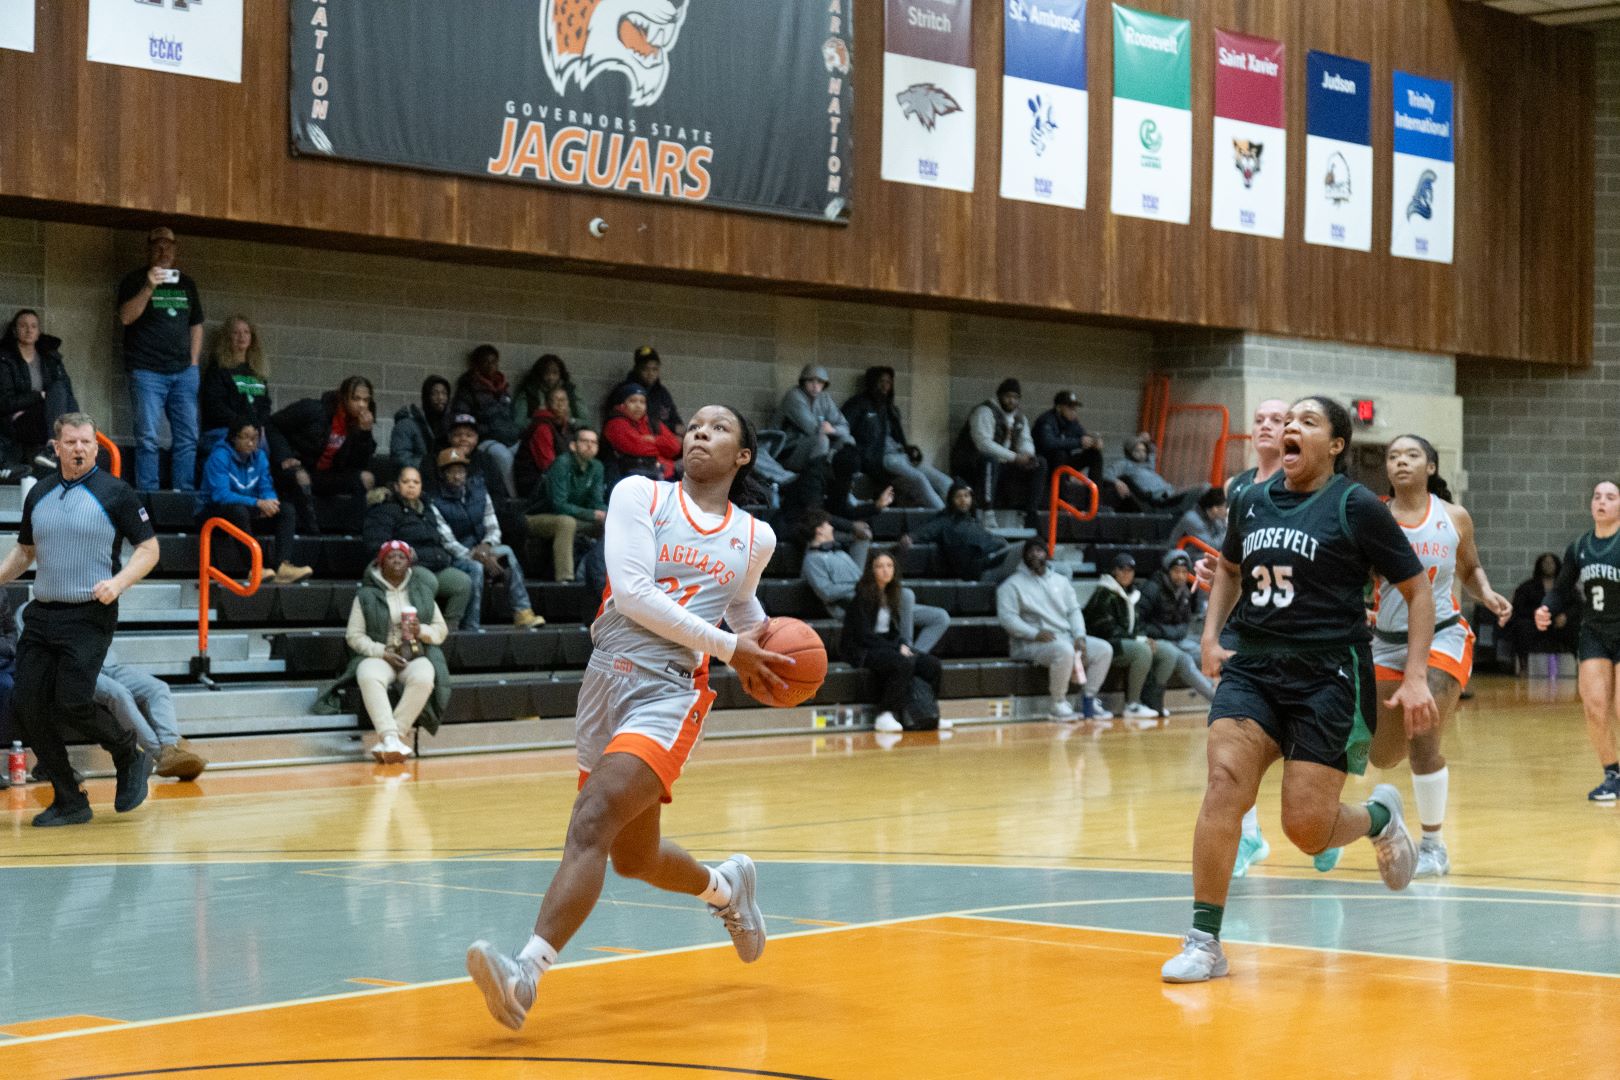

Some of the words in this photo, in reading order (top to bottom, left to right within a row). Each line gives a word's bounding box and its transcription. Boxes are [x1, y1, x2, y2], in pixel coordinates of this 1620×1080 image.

[908, 6, 951, 33] Stritch
[1030, 5, 1080, 33] Ambrose
[149, 38, 182, 61] CCAC
[1126, 26, 1178, 54] Roosevelt
[310, 0, 328, 120] ATION
[1219, 47, 1246, 70] Saint
[1247, 53, 1278, 77] Xavier
[1321, 70, 1356, 95] Judson
[1407, 89, 1435, 116] Trinity
[505, 100, 637, 133] GOVERNORS
[651, 122, 712, 145] STATE
[827, 77, 842, 193] NATION
[1395, 110, 1449, 137] International
[487, 116, 714, 202] JAGUARS
[658, 543, 736, 586] AGUARS
[1251, 565, 1295, 608] 35
[1591, 585, 1605, 611] 2
